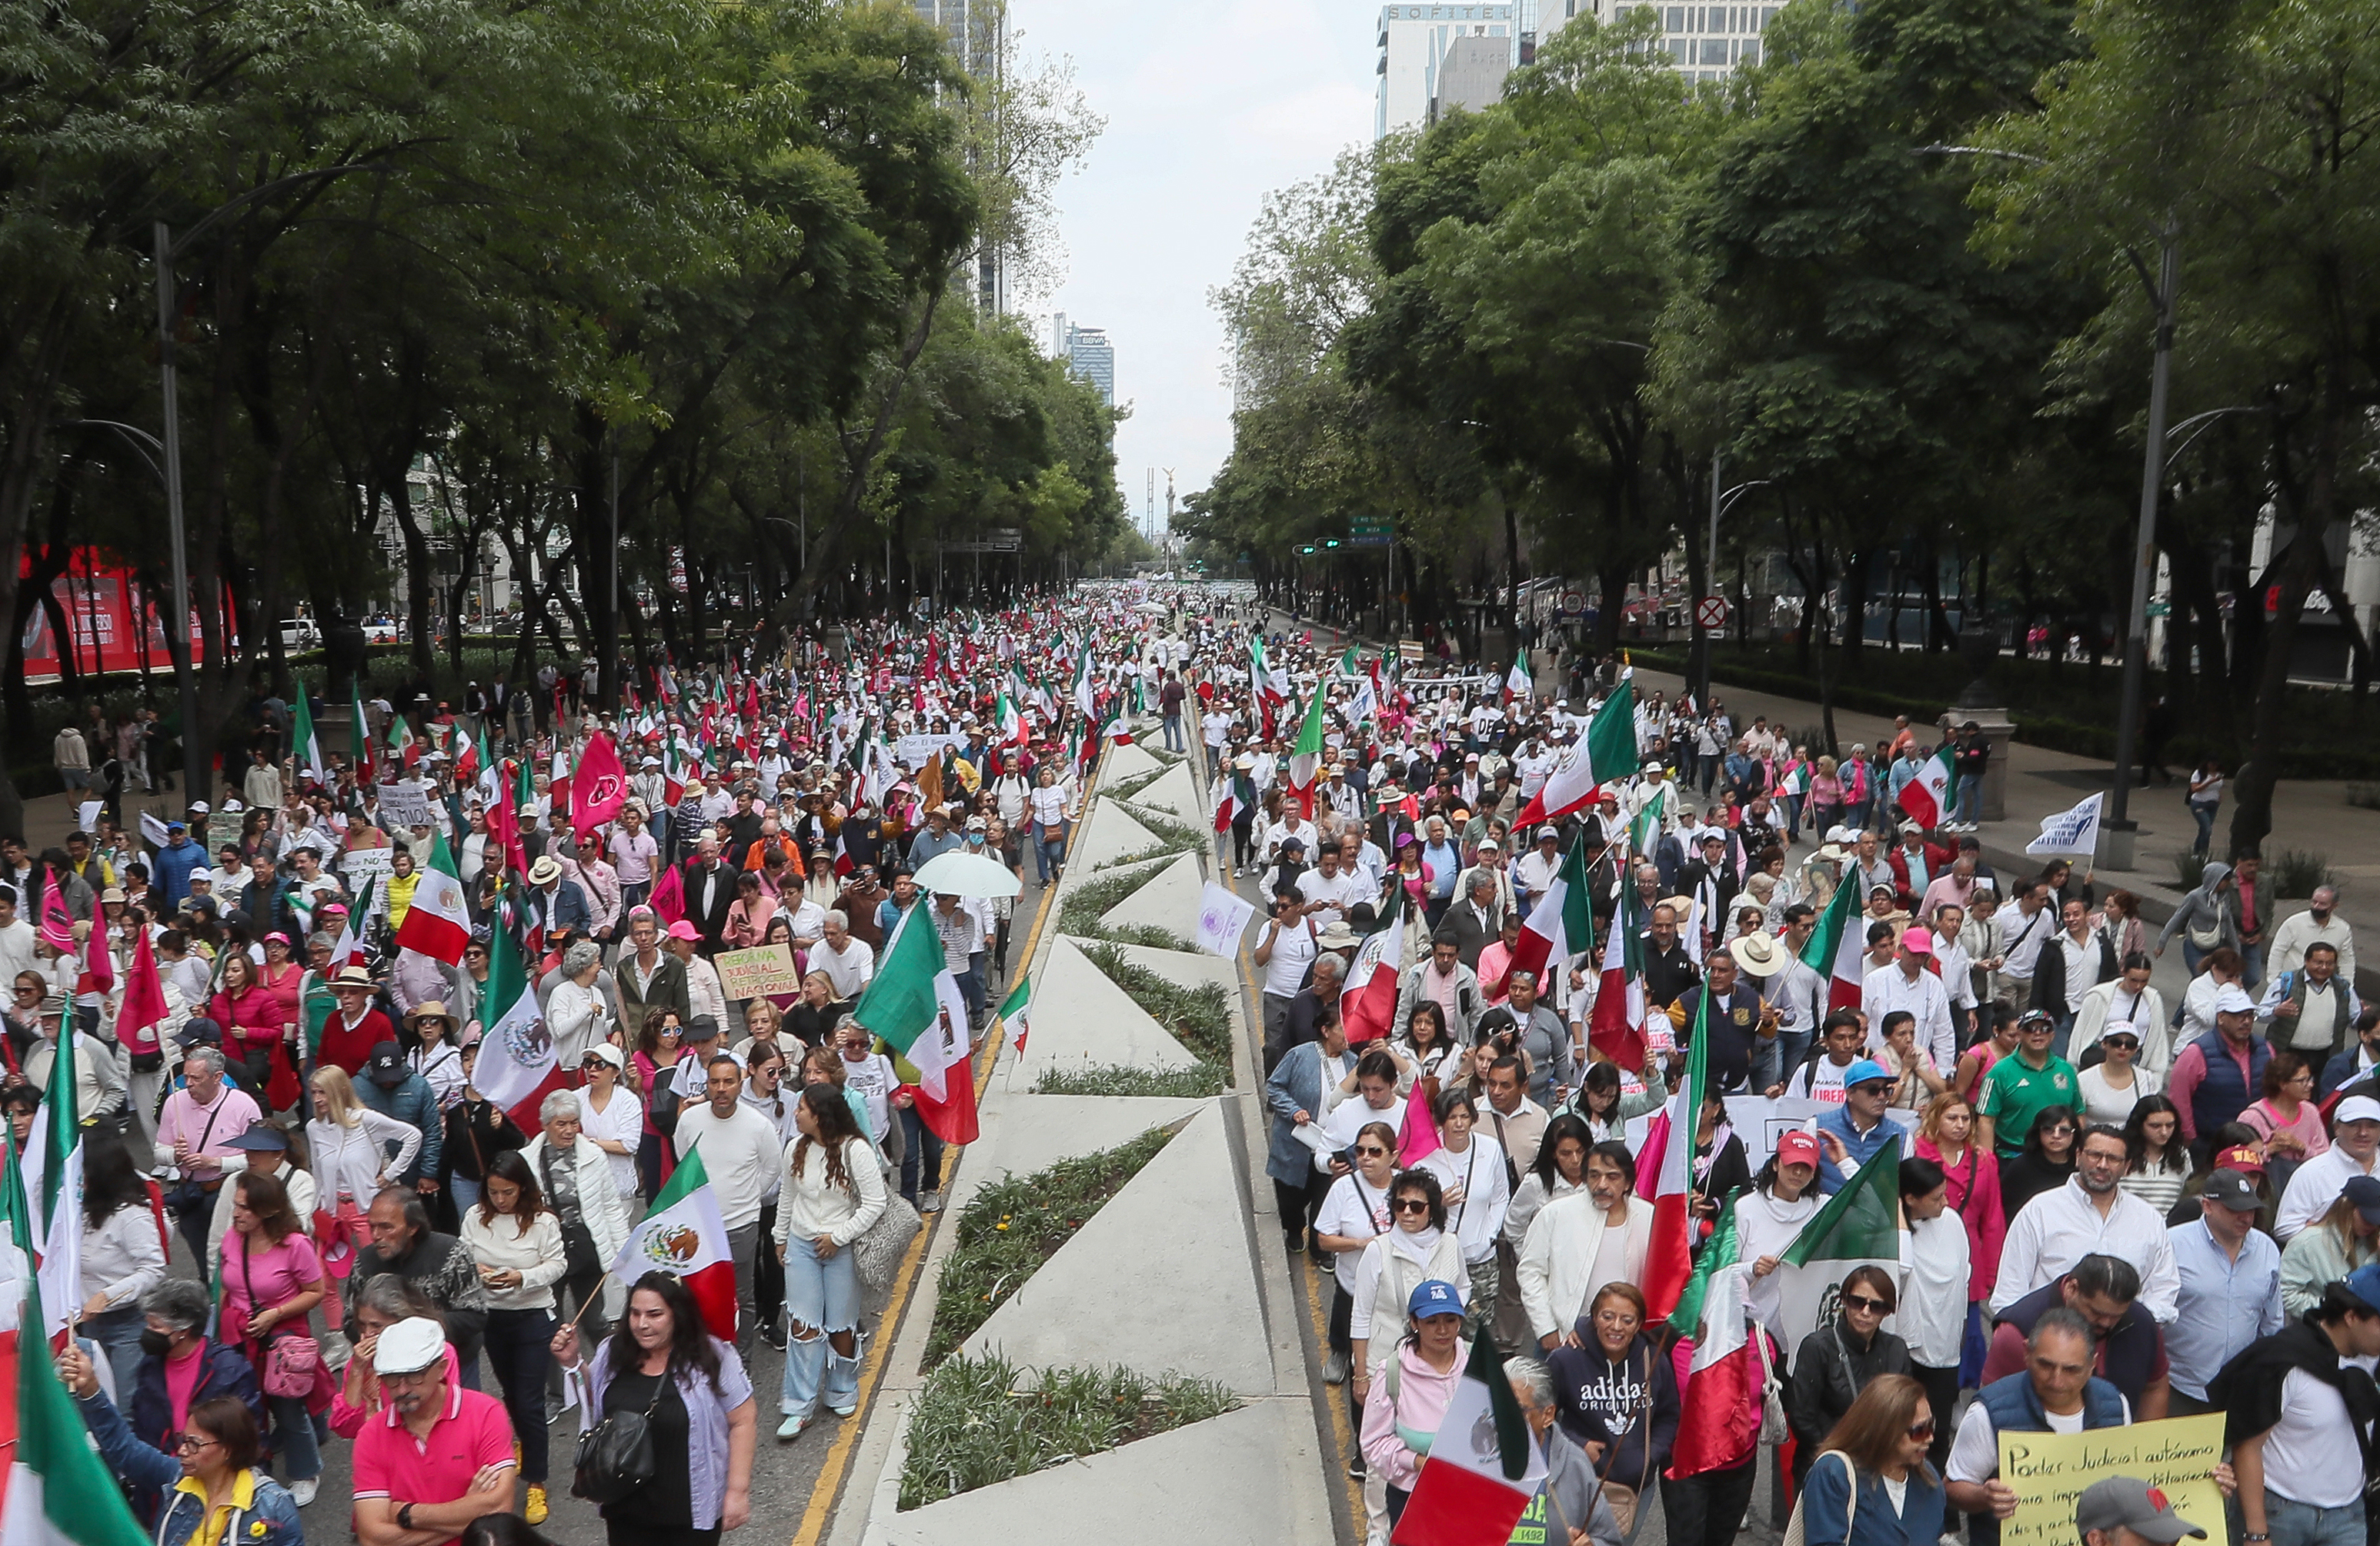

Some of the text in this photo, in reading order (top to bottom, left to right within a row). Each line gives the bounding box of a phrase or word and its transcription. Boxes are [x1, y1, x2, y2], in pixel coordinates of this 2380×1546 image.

[1389, 7, 1511, 18] SOFITEL
[726, 962, 783, 978] JUDICIAL
[734, 980, 799, 999] NACIONAL
[1581, 1376, 1647, 1400] adidas
[2009, 1437, 2214, 1478] Poder Judicial autónomo
